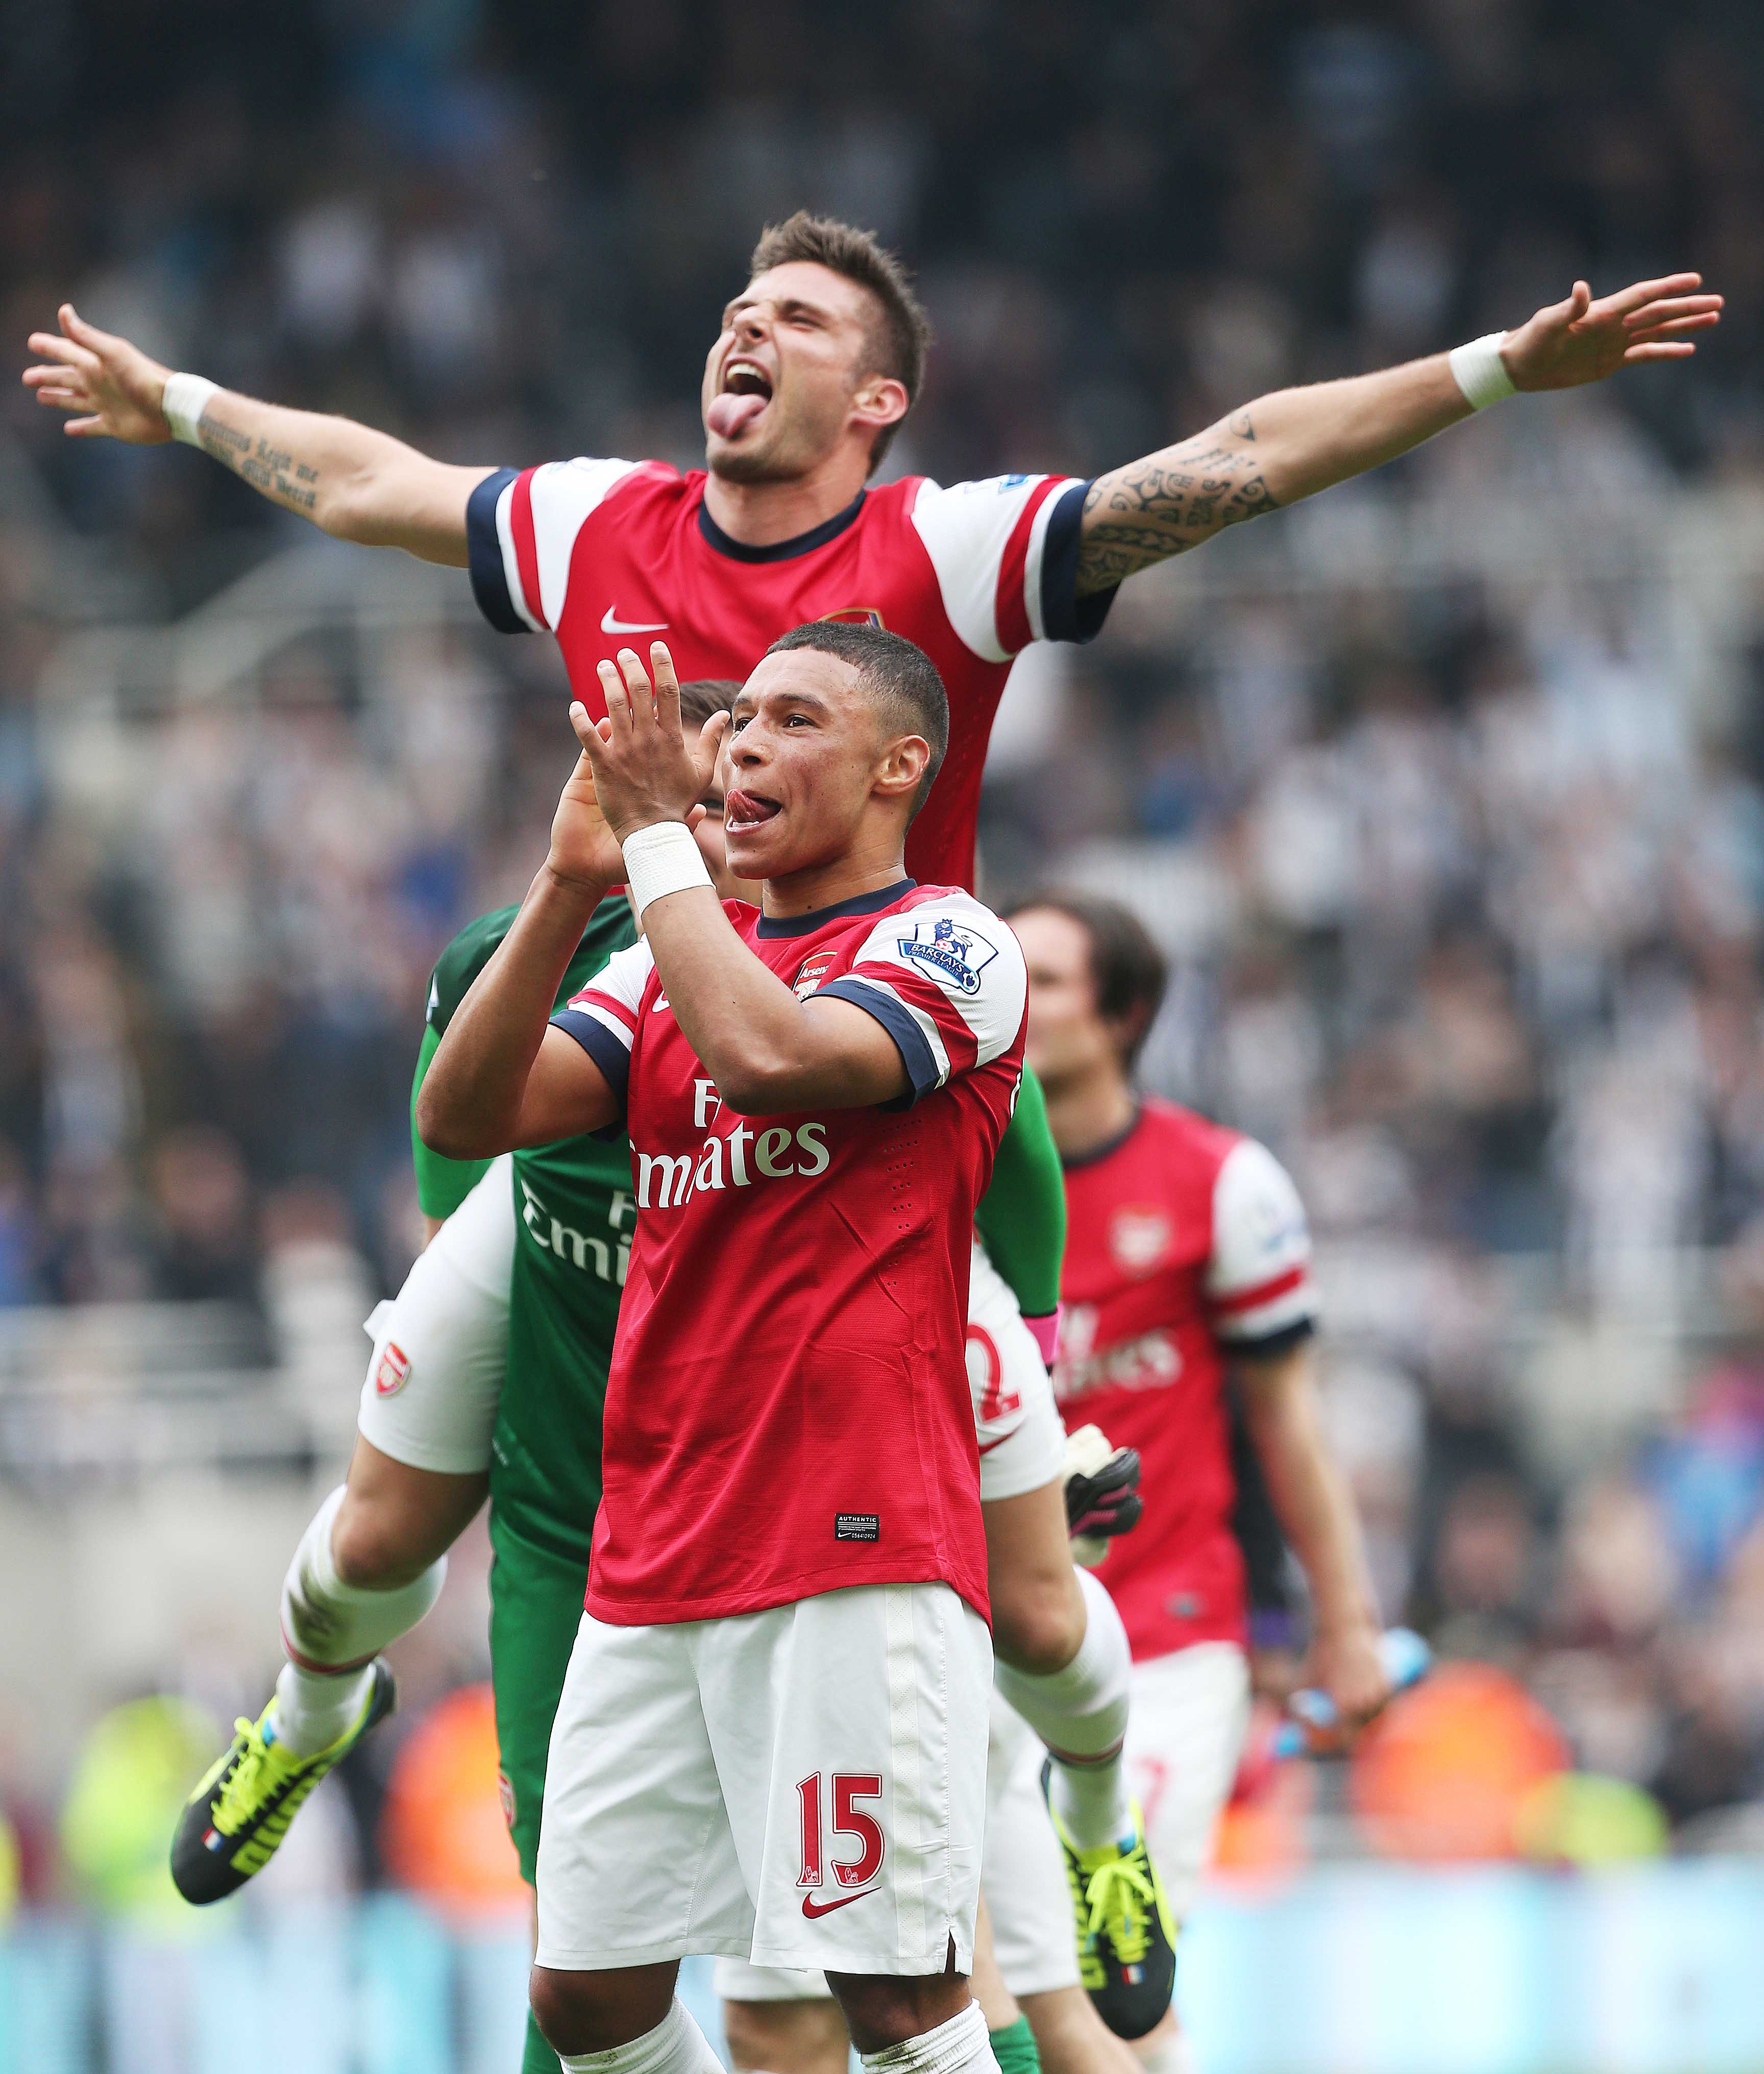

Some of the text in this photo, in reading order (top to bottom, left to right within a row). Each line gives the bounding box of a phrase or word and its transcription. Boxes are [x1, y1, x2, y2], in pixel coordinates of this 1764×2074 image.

[800, 965, 829, 979] Arsen
[908, 951, 960, 976] PREMIER LEAGUE
[911, 944, 964, 972] BARCLAYS
[521, 1179, 633, 1288] Emi
[795, 1771, 886, 1888] 15
